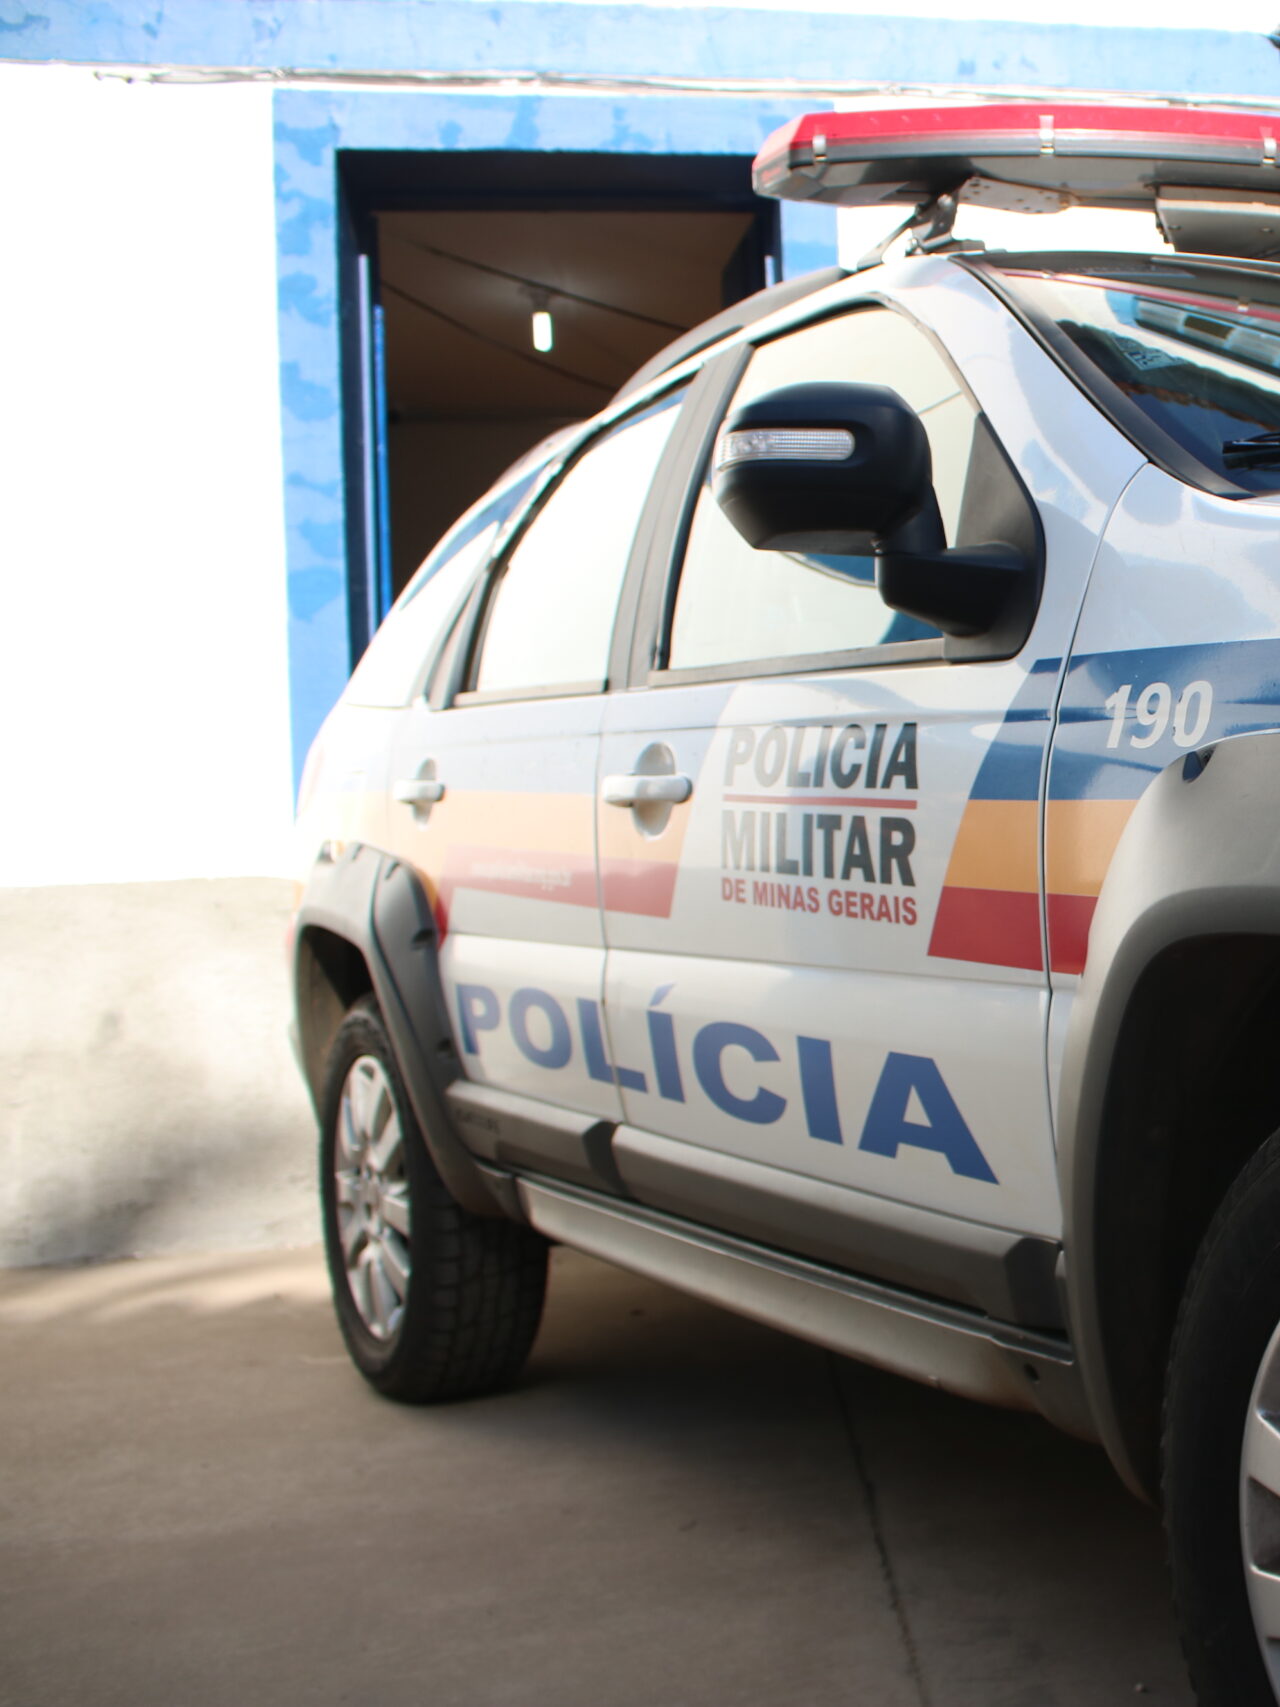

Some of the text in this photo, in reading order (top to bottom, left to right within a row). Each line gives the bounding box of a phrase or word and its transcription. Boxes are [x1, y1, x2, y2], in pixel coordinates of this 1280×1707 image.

[1104, 681, 1213, 749] 190
[723, 722, 918, 789] POLICIA
[721, 809, 916, 887] MILITAR
[721, 877, 918, 926] DE MINAS GERAIS
[455, 982, 1000, 1185] POLÍCIA
